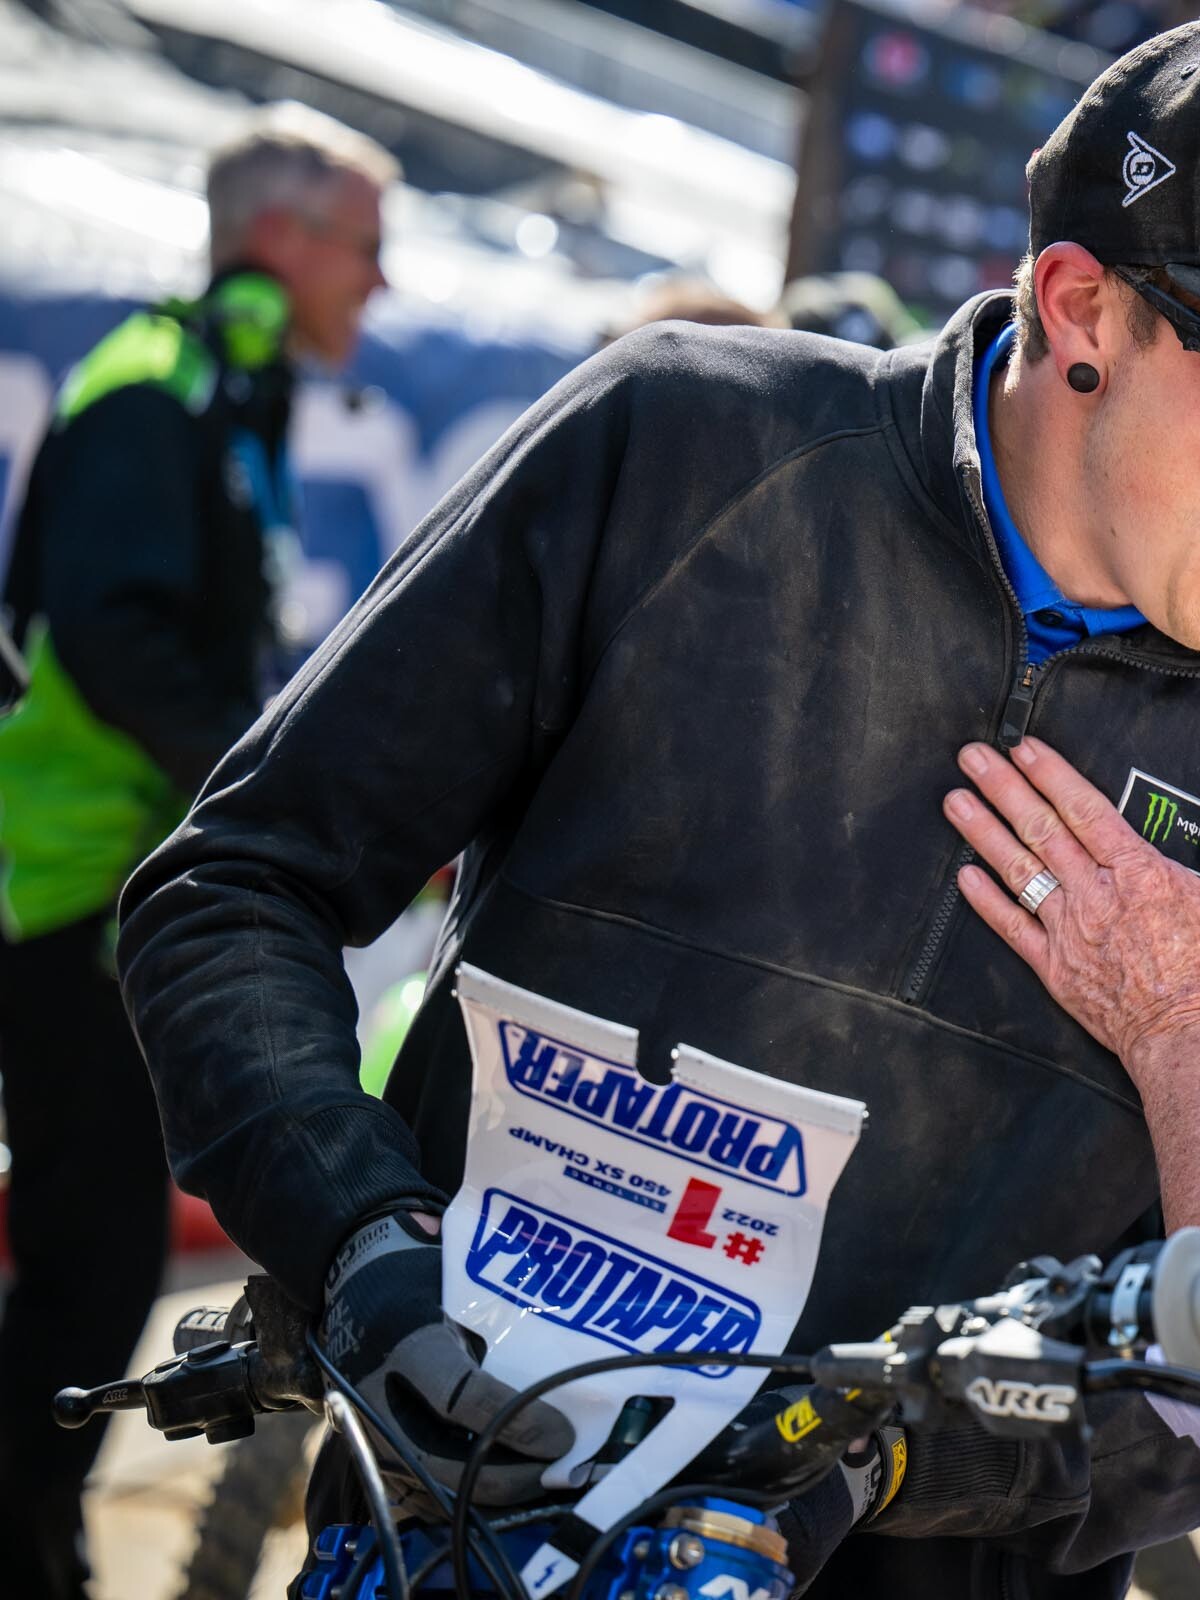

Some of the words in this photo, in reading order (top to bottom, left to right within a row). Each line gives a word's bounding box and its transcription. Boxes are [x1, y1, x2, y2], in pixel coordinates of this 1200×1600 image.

[511, 1032, 791, 1182] PROTAPER
[508, 1126, 590, 1167] CHAMP
[570, 1169, 625, 1198] TOMAC
[593, 1159, 625, 1180] SX
[628, 1174, 672, 1198] 450
[721, 1206, 780, 1237] 2022
[492, 1205, 750, 1358] PROTAPER
